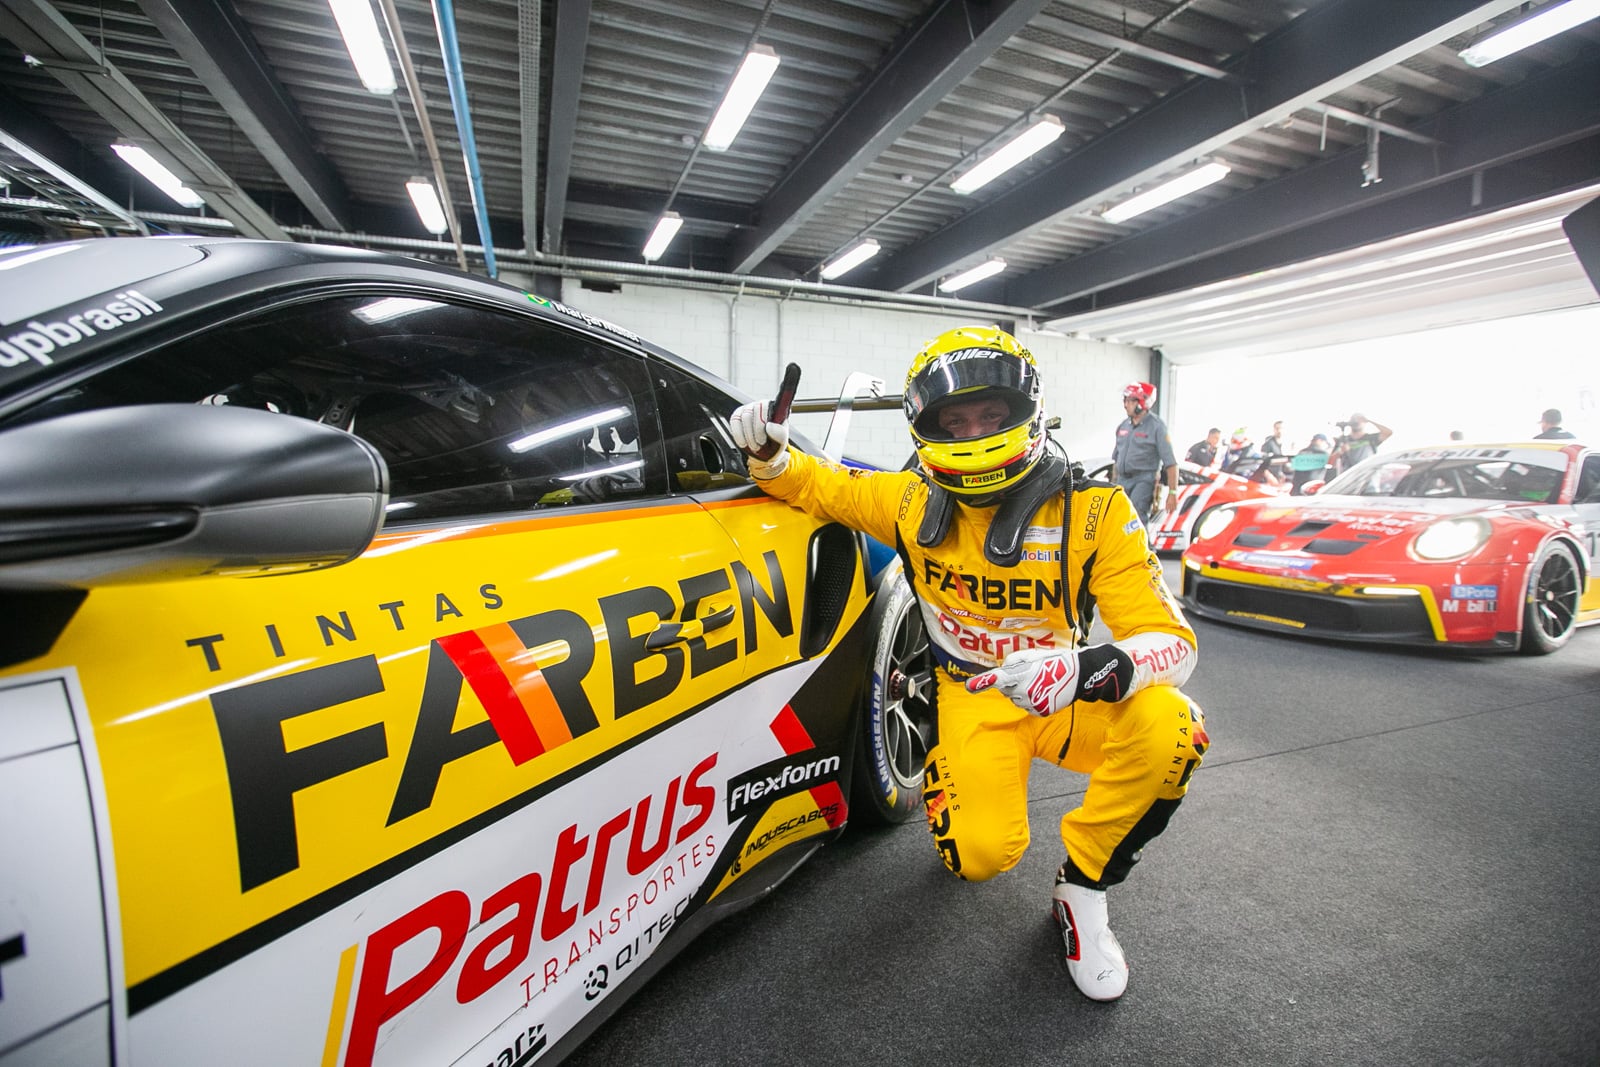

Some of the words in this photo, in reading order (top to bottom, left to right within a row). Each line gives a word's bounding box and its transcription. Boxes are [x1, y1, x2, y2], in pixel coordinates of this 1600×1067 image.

[899, 480, 918, 520] sparco
[965, 472, 1004, 485] FARBEN
[1084, 495, 1103, 541] sparco
[1020, 549, 1050, 561] Mobil
[923, 557, 1063, 611] FARBEN
[1442, 600, 1484, 612] Mbil
[187, 583, 504, 672] TINTAS
[209, 549, 795, 894] FARBEN
[873, 683, 890, 784] MICHELIN
[1163, 711, 1187, 785] TINTAS
[730, 755, 840, 812] Flexform
[940, 756, 960, 811] TINTAS
[745, 802, 839, 857] INDUSCABOS
[343, 752, 719, 1067] Patrus
[519, 835, 716, 1009] TRANSPORTES
[616, 936, 639, 970] QI
